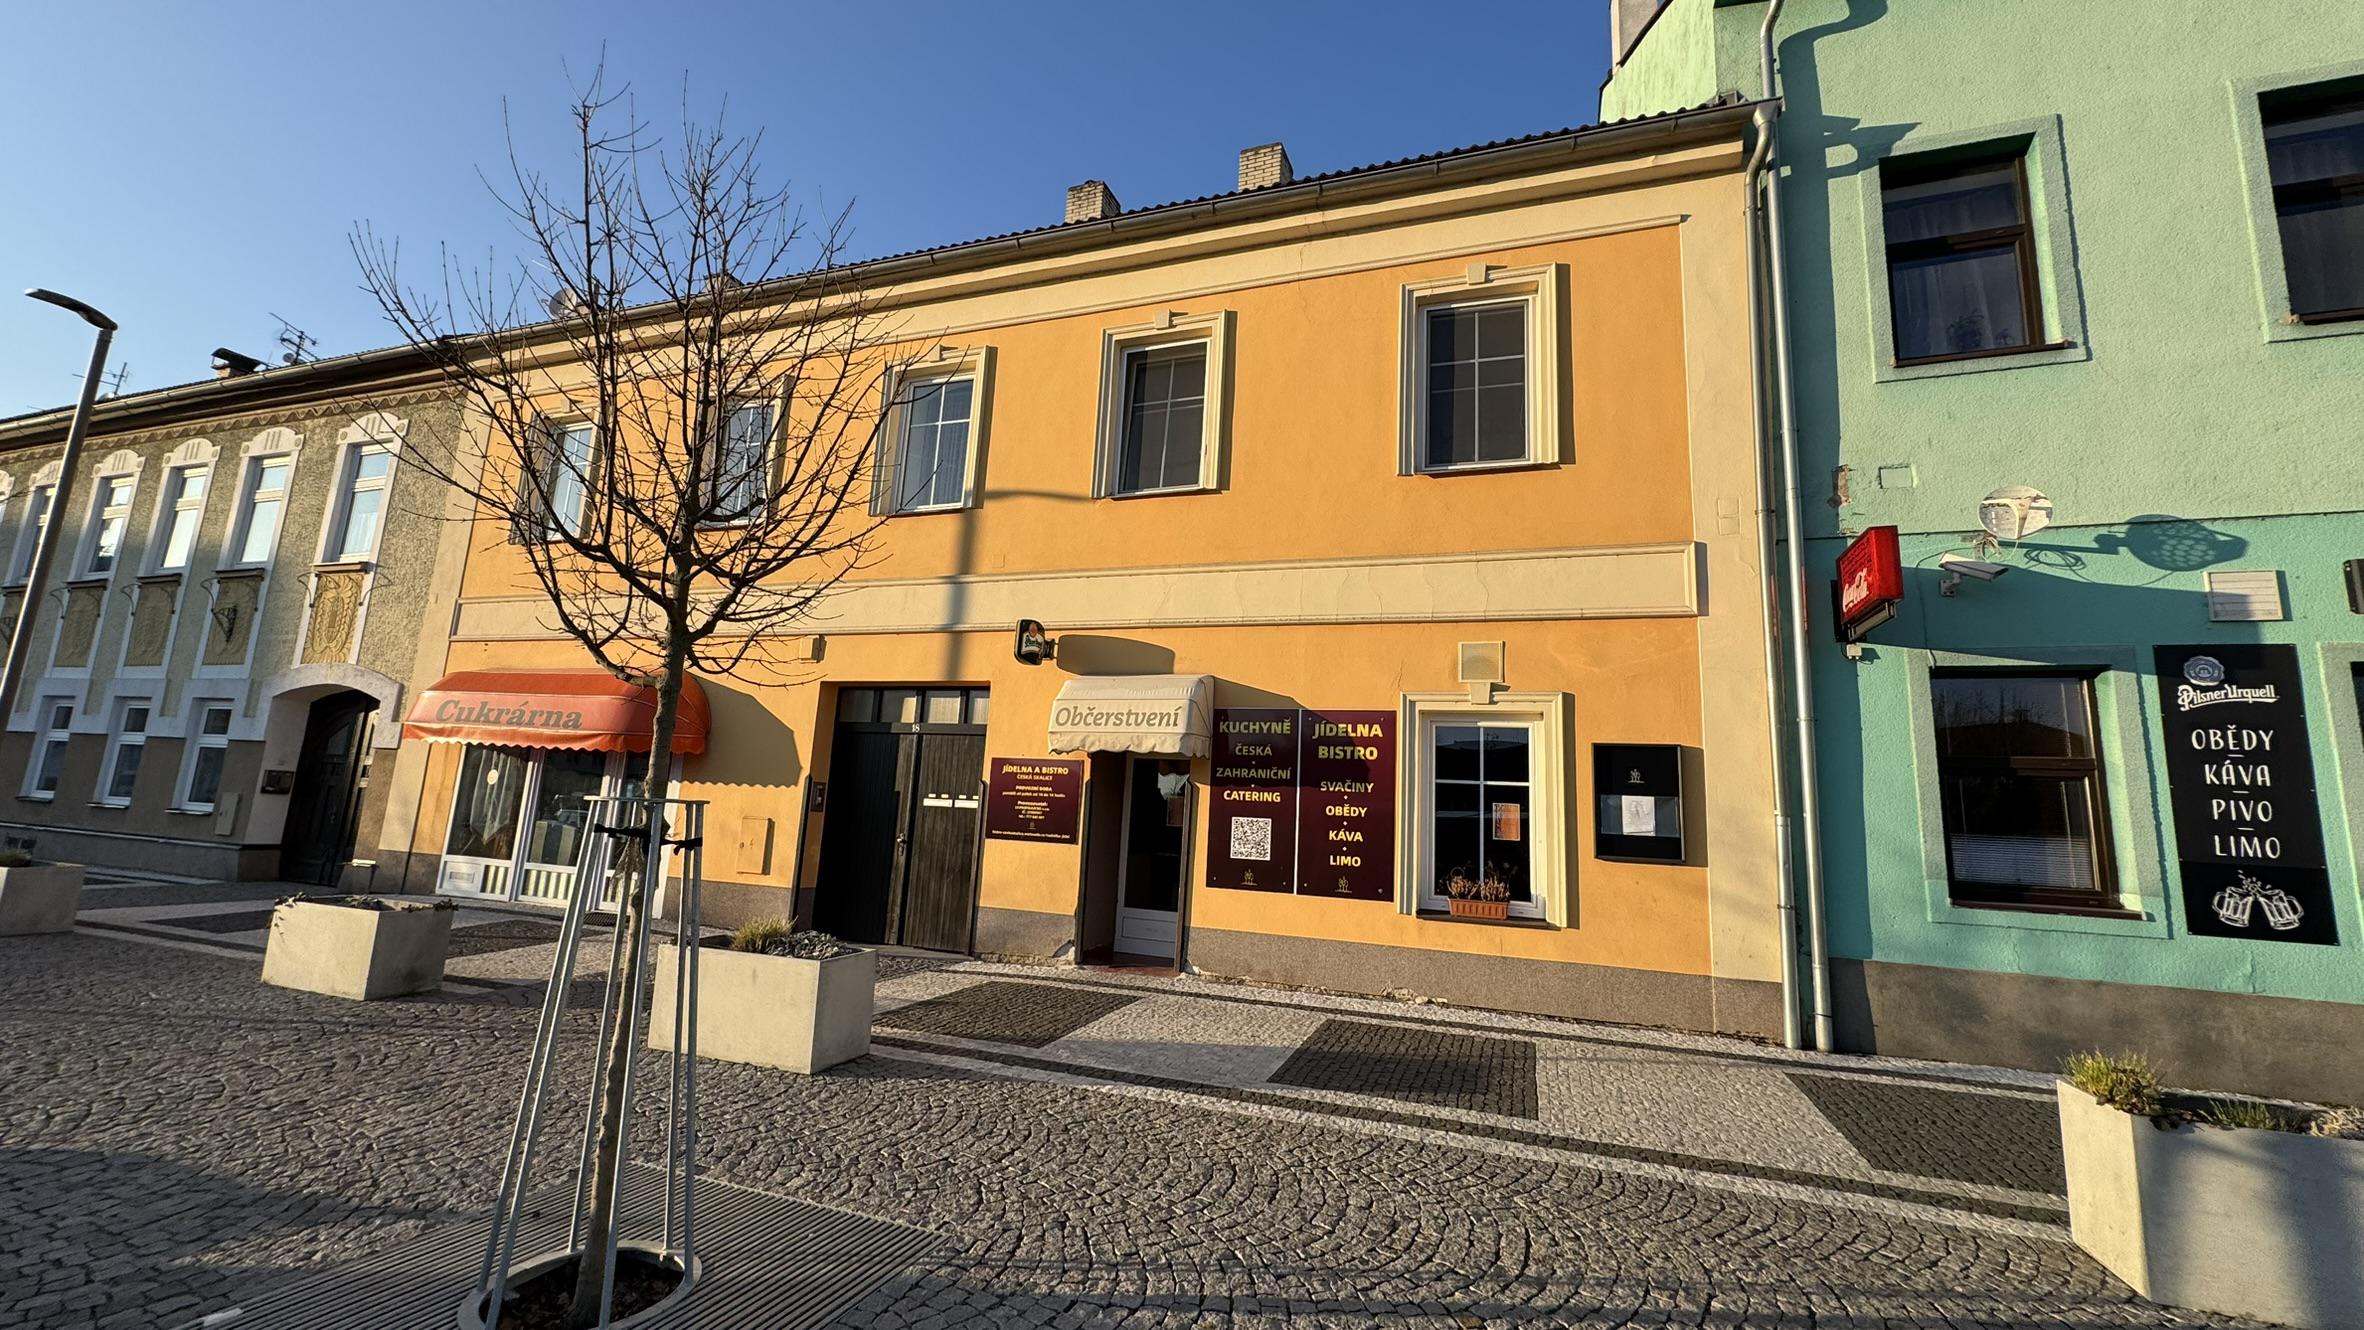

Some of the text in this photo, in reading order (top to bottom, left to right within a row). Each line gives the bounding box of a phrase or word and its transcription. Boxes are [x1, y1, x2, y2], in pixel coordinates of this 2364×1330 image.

[2177, 684, 2275, 711] Pilsner Urquell
[435, 699, 583, 730] Cukrárna
[1055, 705, 1182, 727] Občerstvení
[912, 723, 920, 733] 18
[1219, 717, 1291, 734] KUCHYNĚ
[1312, 720, 1383, 739] JÍDELNA
[2191, 724, 2274, 751] OBĚDY
[1235, 743, 1272, 756] ČESKÁ
[1318, 745, 1378, 761] BISTRO
[1002, 764, 1069, 775] JÍDELNA A BISTRO
[1216, 767, 1291, 779] ZAHRANIČNÍ
[2204, 760, 2271, 787] KÁVA
[1320, 779, 1374, 793] SVAČINY
[1223, 790, 1281, 803] CATERING
[1325, 804, 1368, 818] OBĚDY
[2211, 800, 2272, 822] PIVO
[1329, 829, 1363, 842] KÁVA
[2214, 835, 2281, 859] LIMO
[1329, 855, 1361, 867] LIMO
